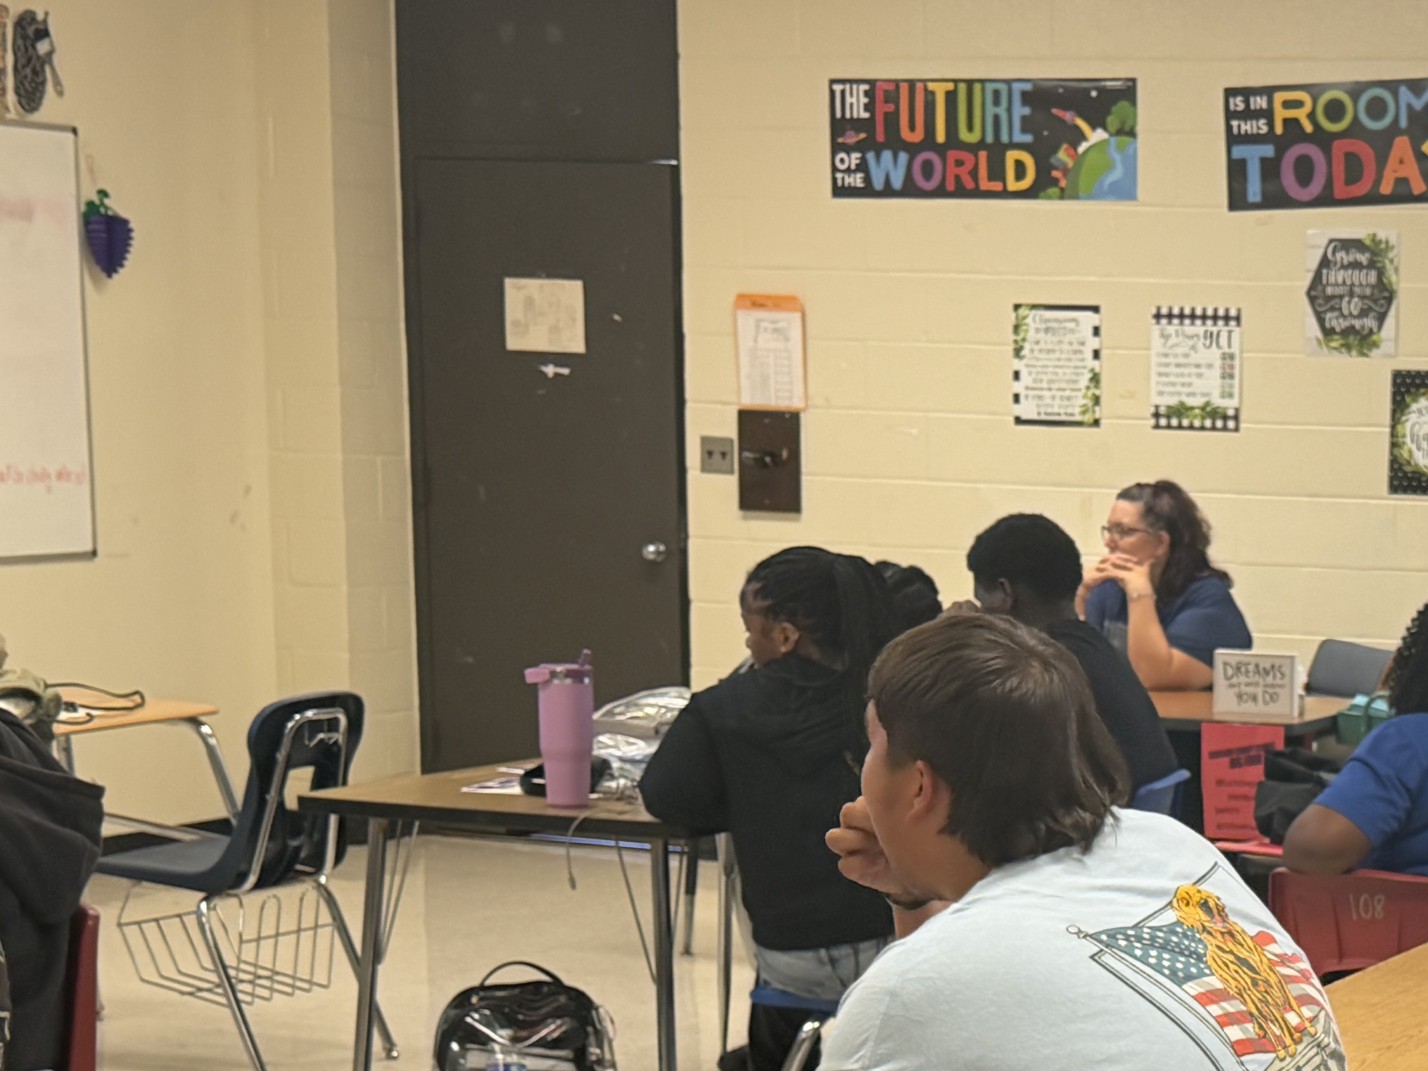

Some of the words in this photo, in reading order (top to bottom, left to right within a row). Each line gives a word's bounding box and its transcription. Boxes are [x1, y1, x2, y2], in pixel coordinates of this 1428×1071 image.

[831, 84, 870, 119] THE
[875, 81, 1034, 143] FUTURE
[1229, 96, 1245, 112] IS
[1250, 95, 1268, 111] IN
[1230, 119, 1269, 135] THIS
[835, 153, 862, 170] OF
[835, 172, 866, 188] THE
[866, 150, 1036, 192] WORLD
[1222, 661, 1286, 681] DREAMS
[1350, 894, 1385, 919] 108
